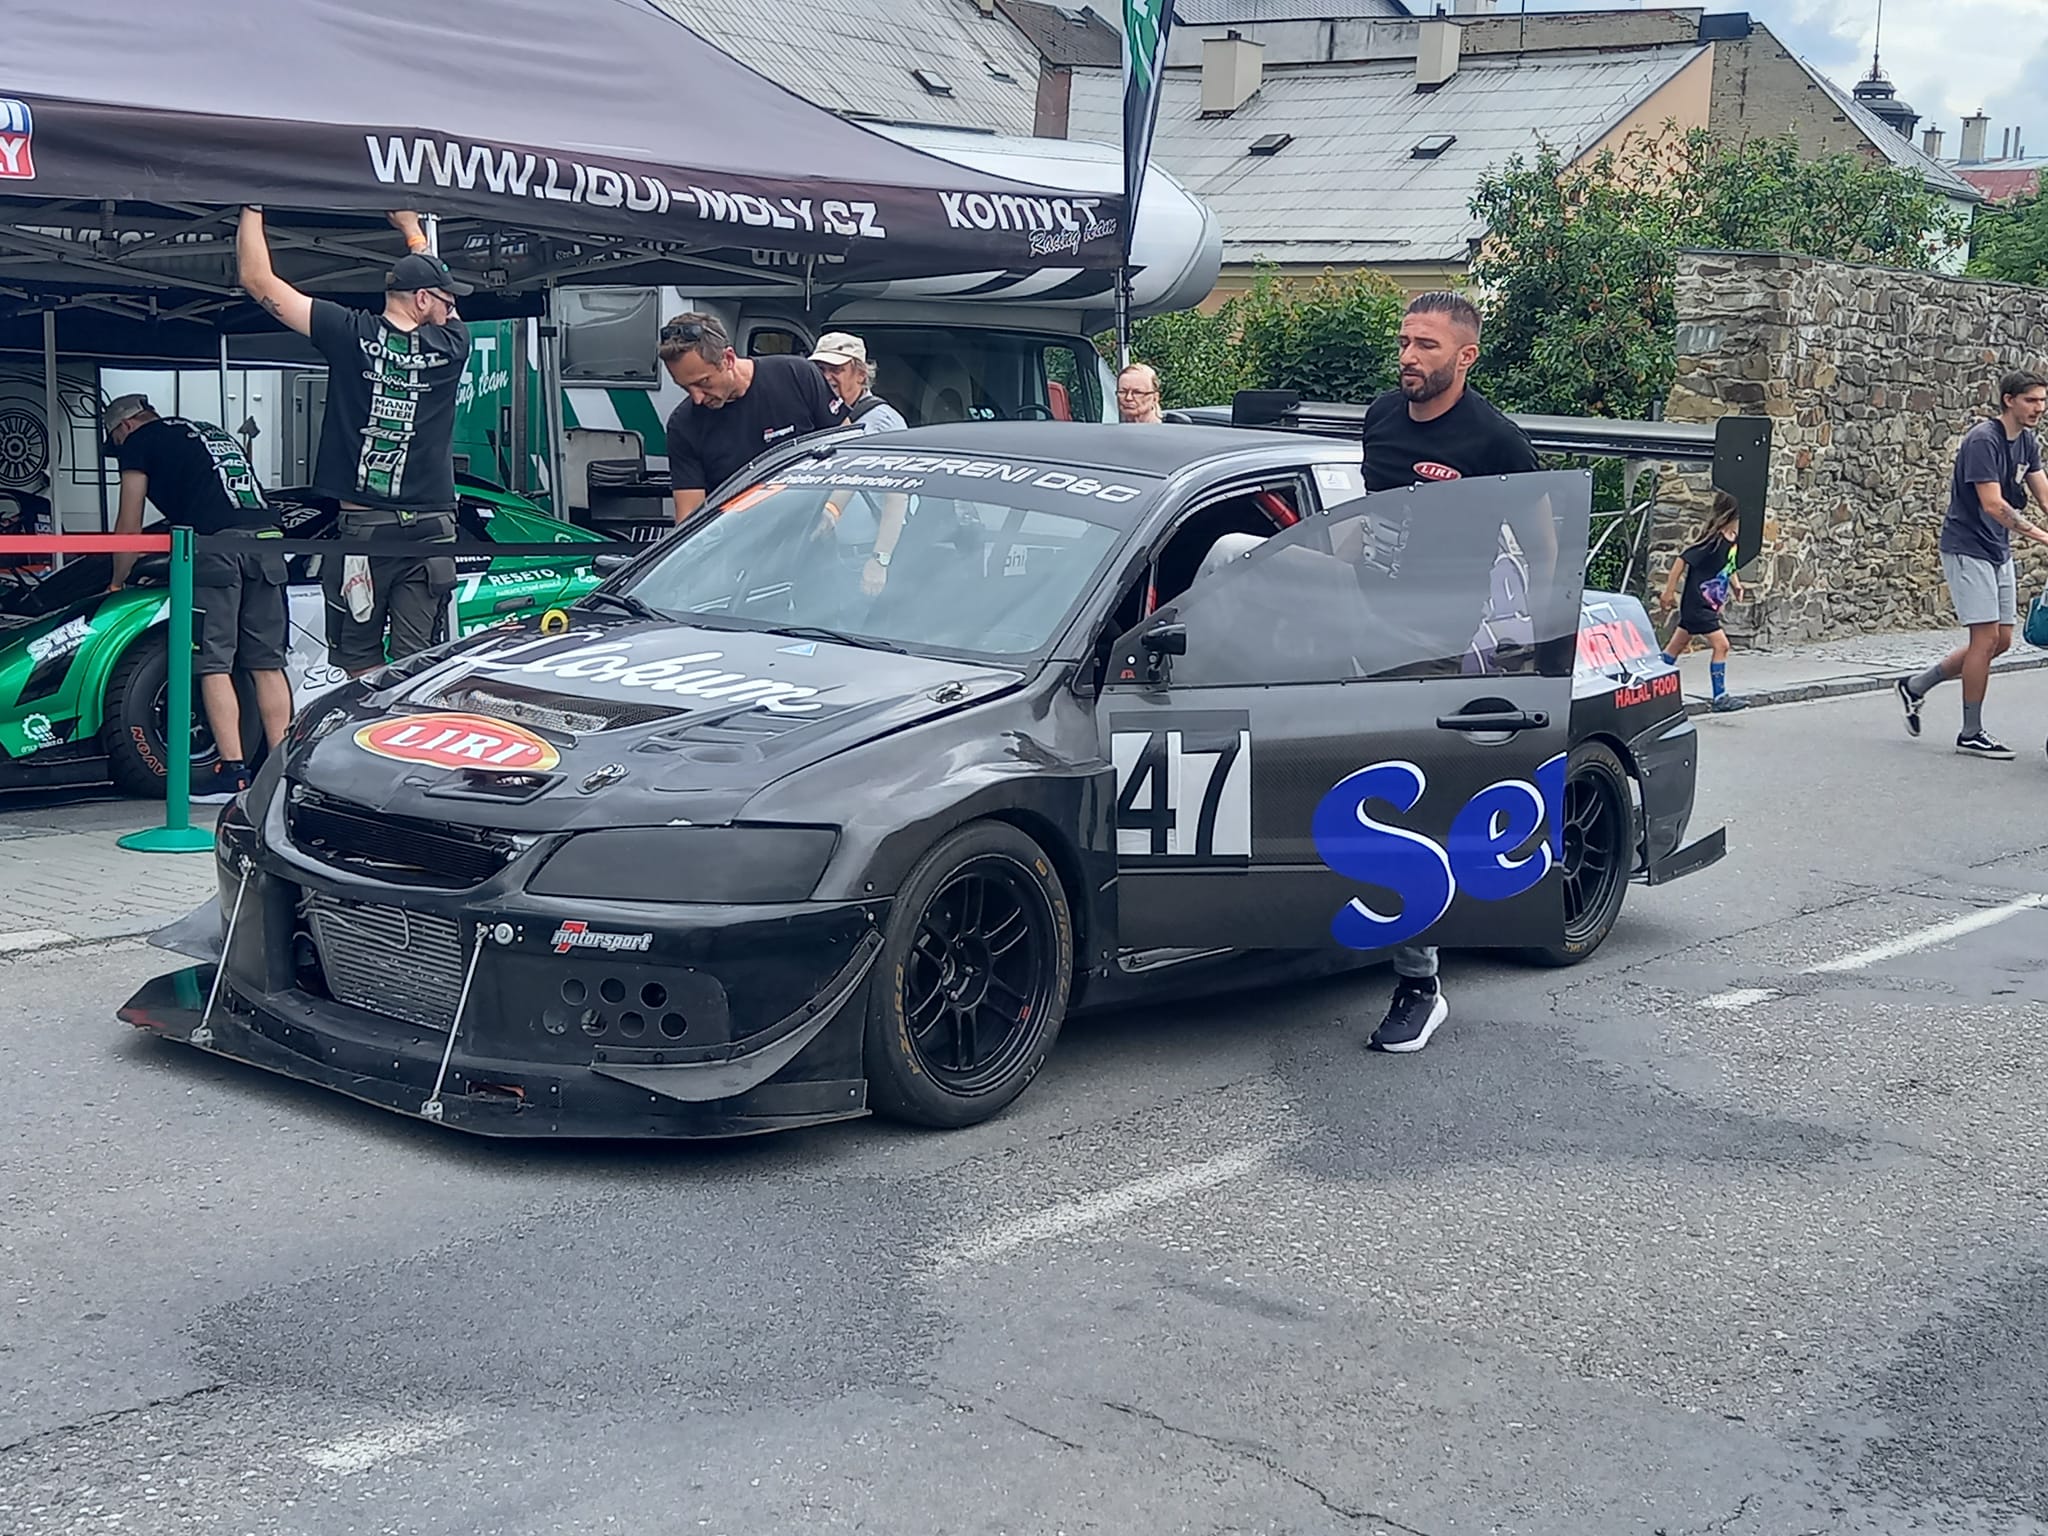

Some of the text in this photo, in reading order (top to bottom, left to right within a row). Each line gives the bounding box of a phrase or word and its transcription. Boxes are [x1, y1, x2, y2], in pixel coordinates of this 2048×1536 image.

[373, 405, 413, 420] FILTER
[374, 397, 415, 412] MANN
[841, 456, 1038, 483] PRIZRENI
[1419, 464, 1454, 479] LIRI
[1614, 674, 1678, 709] HALAL FOOD
[382, 725, 533, 763] LIRI
[1117, 729, 1242, 857] 47
[550, 929, 653, 952] motorsport
